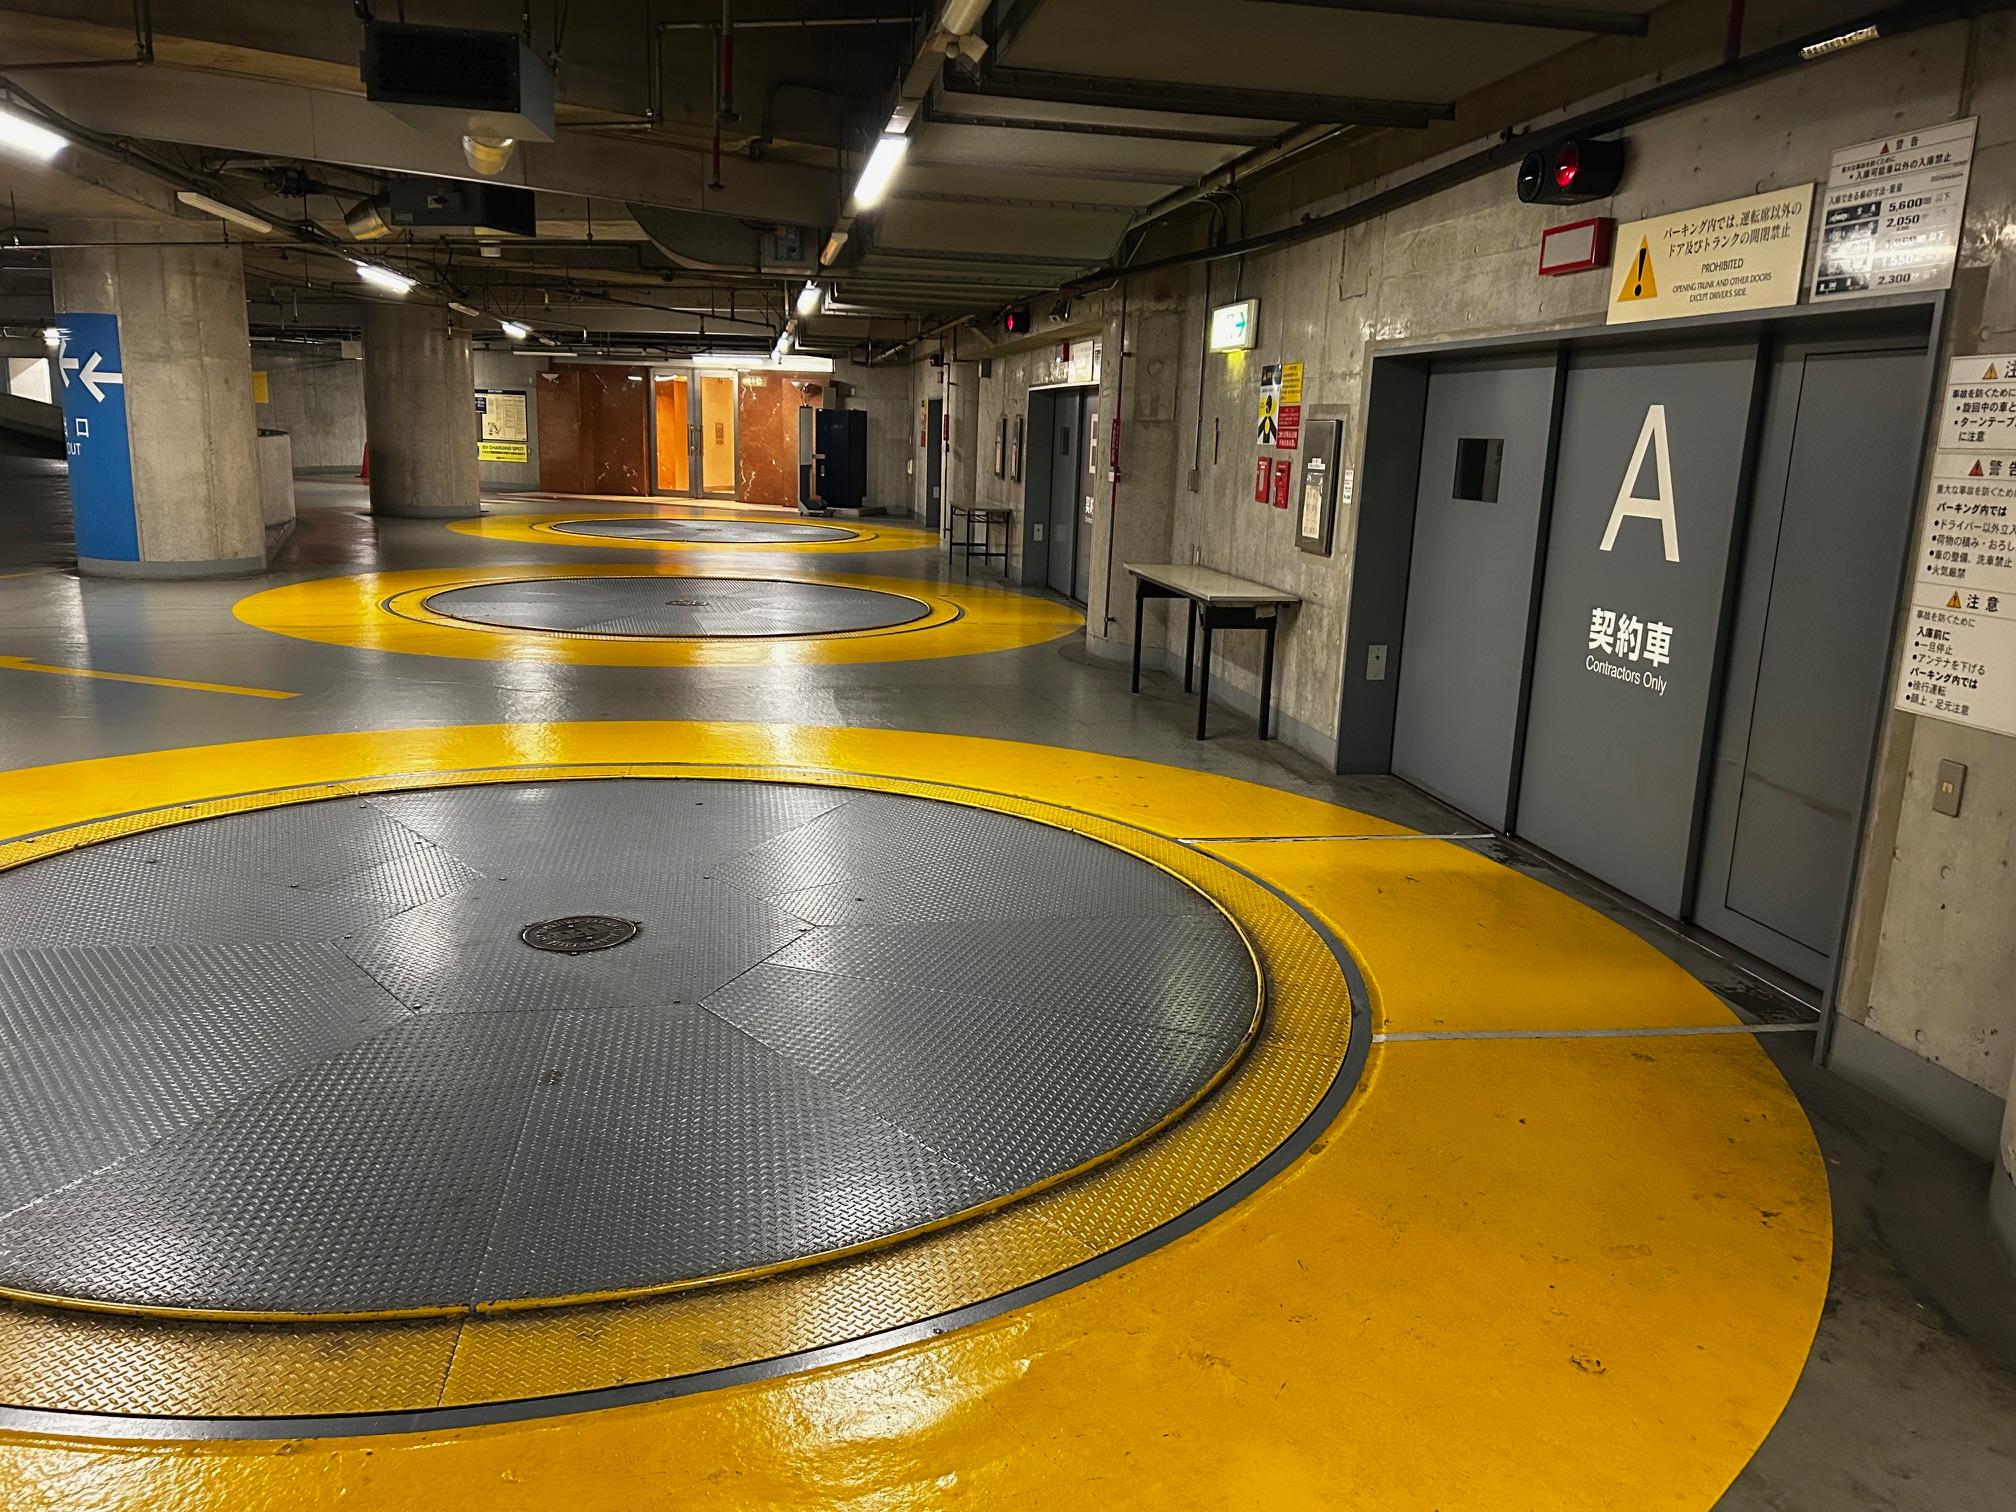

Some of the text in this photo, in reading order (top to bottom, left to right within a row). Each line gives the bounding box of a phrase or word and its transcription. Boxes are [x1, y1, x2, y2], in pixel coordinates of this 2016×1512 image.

[1895, 136, 1919, 150] 警告
[1855, 152, 1952, 180] 入庫可能車以外の入庫禁止
[1664, 201, 1801, 240] パーキング内では、運転席以外の
[1886, 214, 1920, 229] 2,050
[1669, 223, 1791, 258] ドア及びトランクの開閉禁止
[1701, 258, 1744, 274] PROHIBITED
[1672, 272, 1772, 294] OPENING TRUNK AND OTHER DOORS
[1689, 292, 1708, 303] EXCEPT
[1952, 388, 2016, 399] 事故を防ぐために
[1961, 417, 2016, 428] ターンテーブ
[1958, 431, 1985, 442] に注意
[1599, 404, 1680, 563] A
[1937, 502, 2007, 517] パーキング内では
[1936, 534, 2016, 552] 荷物の積み・おろし
[1931, 565, 1966, 578] 火気厳禁
[1966, 594, 2000, 612] 注意
[1916, 610, 1976, 628] 事故を防ぐために
[1588, 607, 1673, 668] 契約車
[1916, 626, 1951, 641] 入庫前に
[1920, 641, 1953, 656] 一旦停止
[1918, 654, 1986, 676] アンテナを下げる
[1586, 655, 1667, 696] Contractors Only
[1910, 667, 1978, 689] パーキング内では
[1913, 680, 1947, 697] 徐行運転
[1910, 692, 1970, 716] 頭上・足元注意
